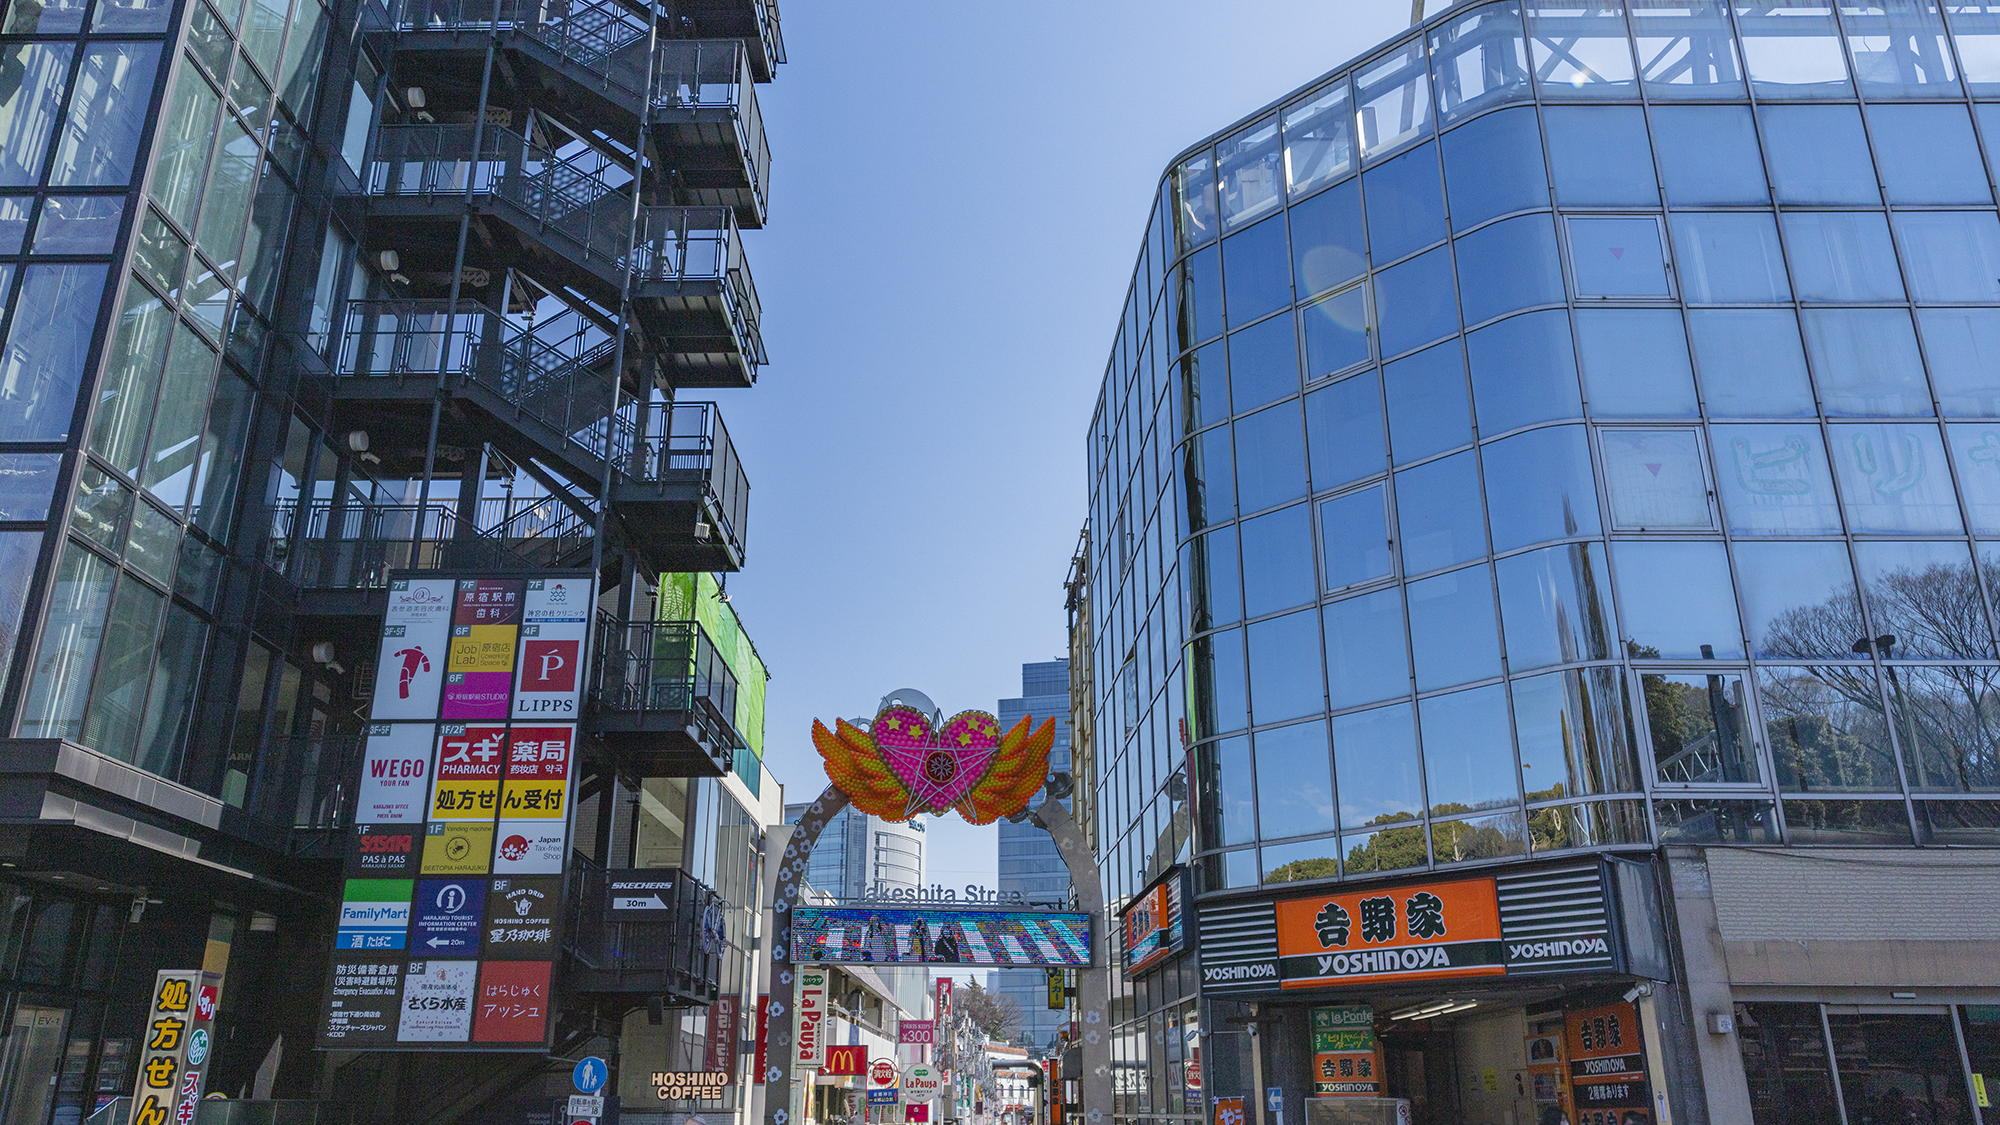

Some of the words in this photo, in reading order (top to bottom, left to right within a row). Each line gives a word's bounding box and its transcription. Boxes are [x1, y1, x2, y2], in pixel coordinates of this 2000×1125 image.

[394, 581, 406, 589] 7F
[462, 581, 474, 589] 7F
[530, 581, 541, 589] 7F
[464, 592, 515, 602] 原宿駅前
[476, 608, 500, 619] 歯科
[455, 627, 469, 635] 6F
[524, 627, 537, 635] 4F
[456, 645, 478, 655] Job
[455, 656, 476, 665] Lab
[449, 674, 463, 682] 6F
[518, 700, 573, 712] LIPPS
[440, 726, 465, 734] 1F/2F
[371, 759, 425, 778] WEGO
[442, 764, 500, 774] PHARMACY
[545, 764, 563, 774] 약국
[357, 825, 370, 834] 1F
[429, 825, 442, 834] 1F
[538, 836, 561, 845] Japan
[361, 855, 380, 863] PAS
[388, 855, 406, 863] PAS
[543, 853, 561, 861] Shop
[494, 880, 508, 891] BF
[343, 907, 408, 921] FamilyMart
[1314, 892, 1447, 948] 吉野家
[490, 928, 552, 943] 星乃珈琲
[351, 934, 365, 948] 酒
[366, 934, 392, 947] たばこ
[409, 963, 423, 973] BF
[333, 987, 358, 996] Emergency
[359, 987, 383, 995] Evacuation
[383, 987, 396, 995] Area
[486, 985, 540, 997] はらじゅく
[408, 996, 468, 1011] さくら水産
[801, 990, 822, 1009] La
[484, 1003, 540, 1018] アッシュ
[1343, 1010, 1374, 1025] Ponte
[797, 1011, 822, 1060] Pausa
[135, 980, 190, 1125] 処方せん
[1322, 1058, 1373, 1078] 吉野家
[651, 1072, 728, 1086] HOSHINO
[905, 1078, 915, 1088] La
[915, 1078, 938, 1089] Pausa
[657, 1086, 722, 1100] COFFEE
